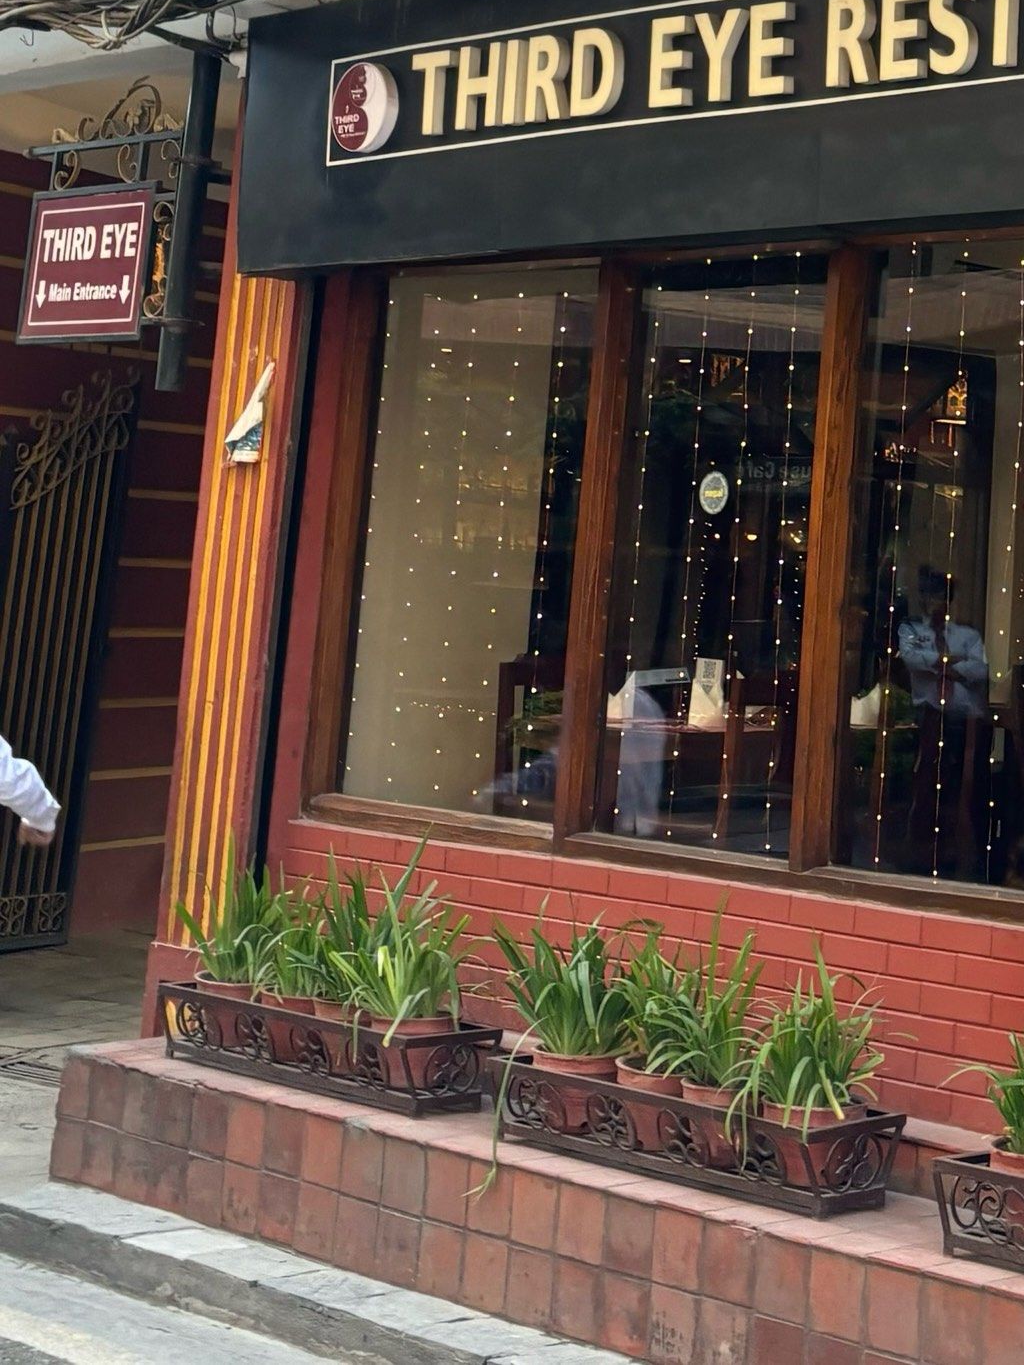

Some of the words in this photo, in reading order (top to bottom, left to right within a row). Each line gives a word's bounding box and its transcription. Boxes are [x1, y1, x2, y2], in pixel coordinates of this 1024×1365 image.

[412, 27, 624, 136] THIRD
[648, 0, 796, 109] EYE
[335, 114, 360, 127] THIRD
[338, 124, 355, 134] EYE
[43, 225, 97, 263] THIRD
[100, 222, 139, 259] EYE
[48, 283, 72, 302] Main
[73, 282, 118, 301] Entrance
